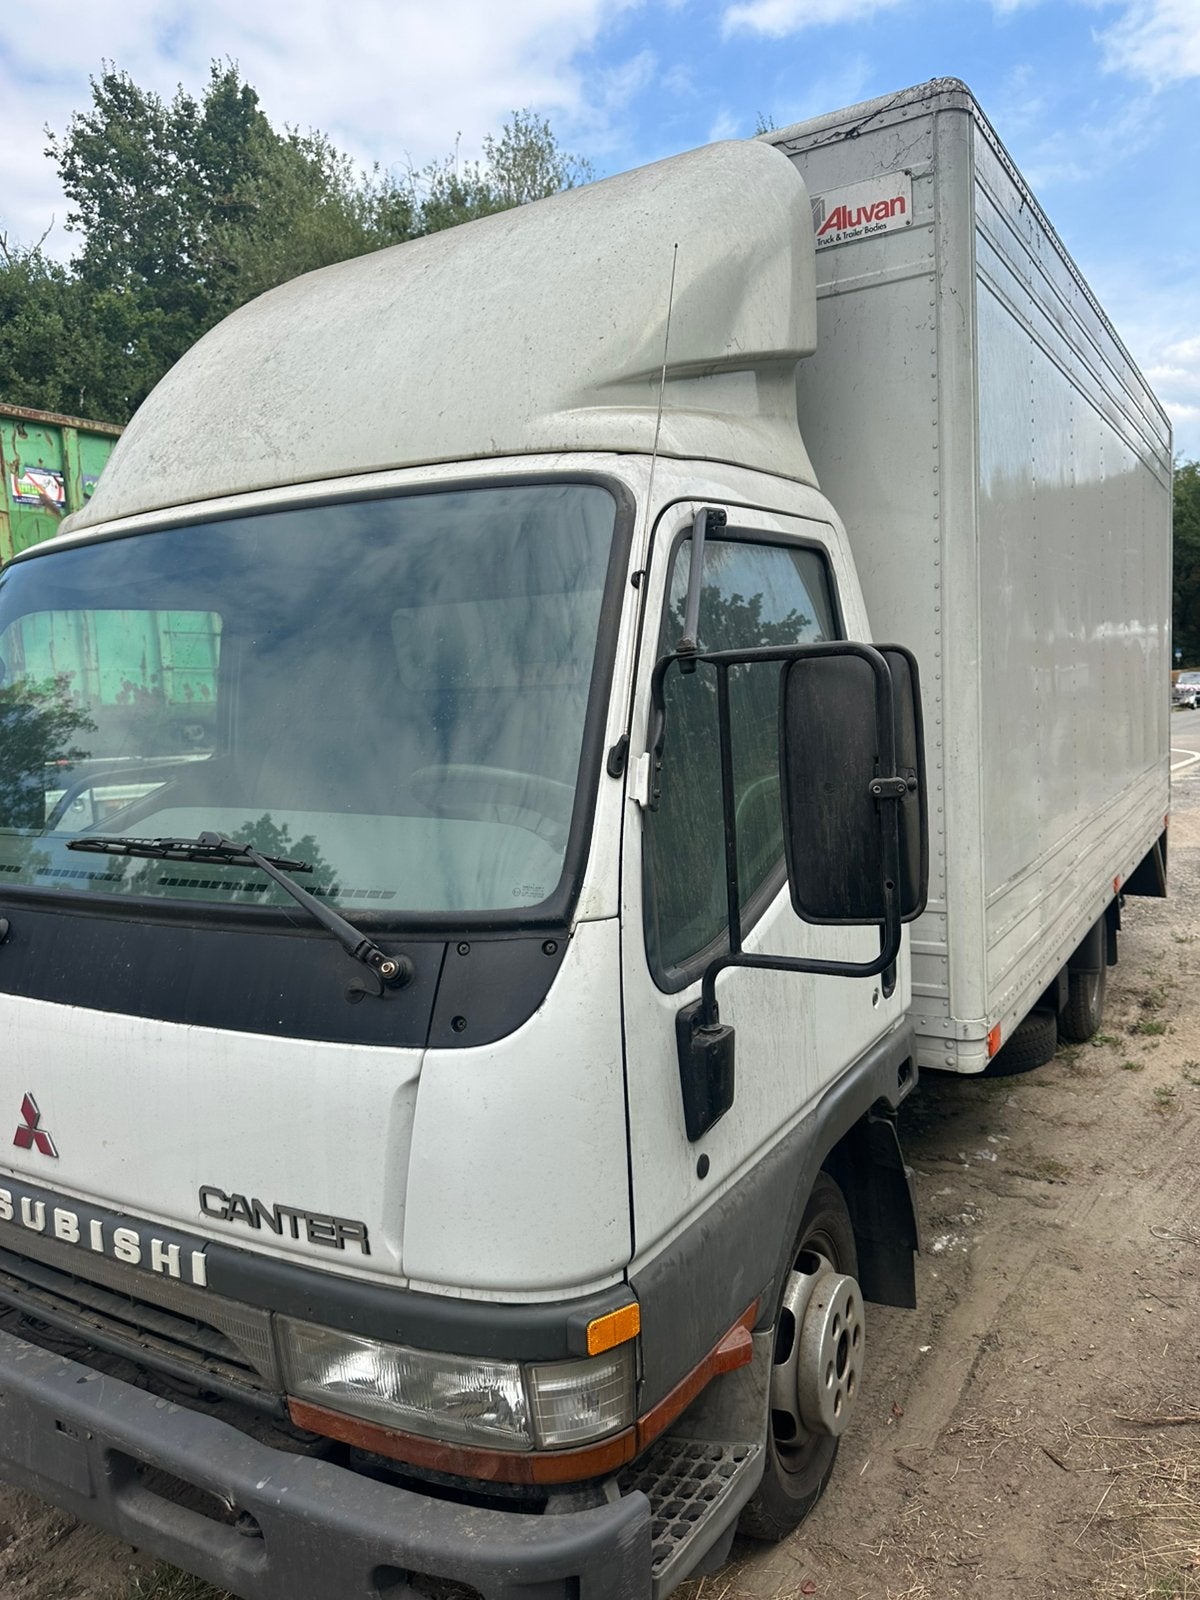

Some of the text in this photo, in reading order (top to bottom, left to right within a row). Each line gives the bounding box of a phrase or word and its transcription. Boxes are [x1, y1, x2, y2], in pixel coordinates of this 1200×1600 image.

[817, 196, 905, 236] Aluvan
[817, 223, 887, 246] Truck & Trailer Bodies
[199, 1184, 371, 1256] CANTER
